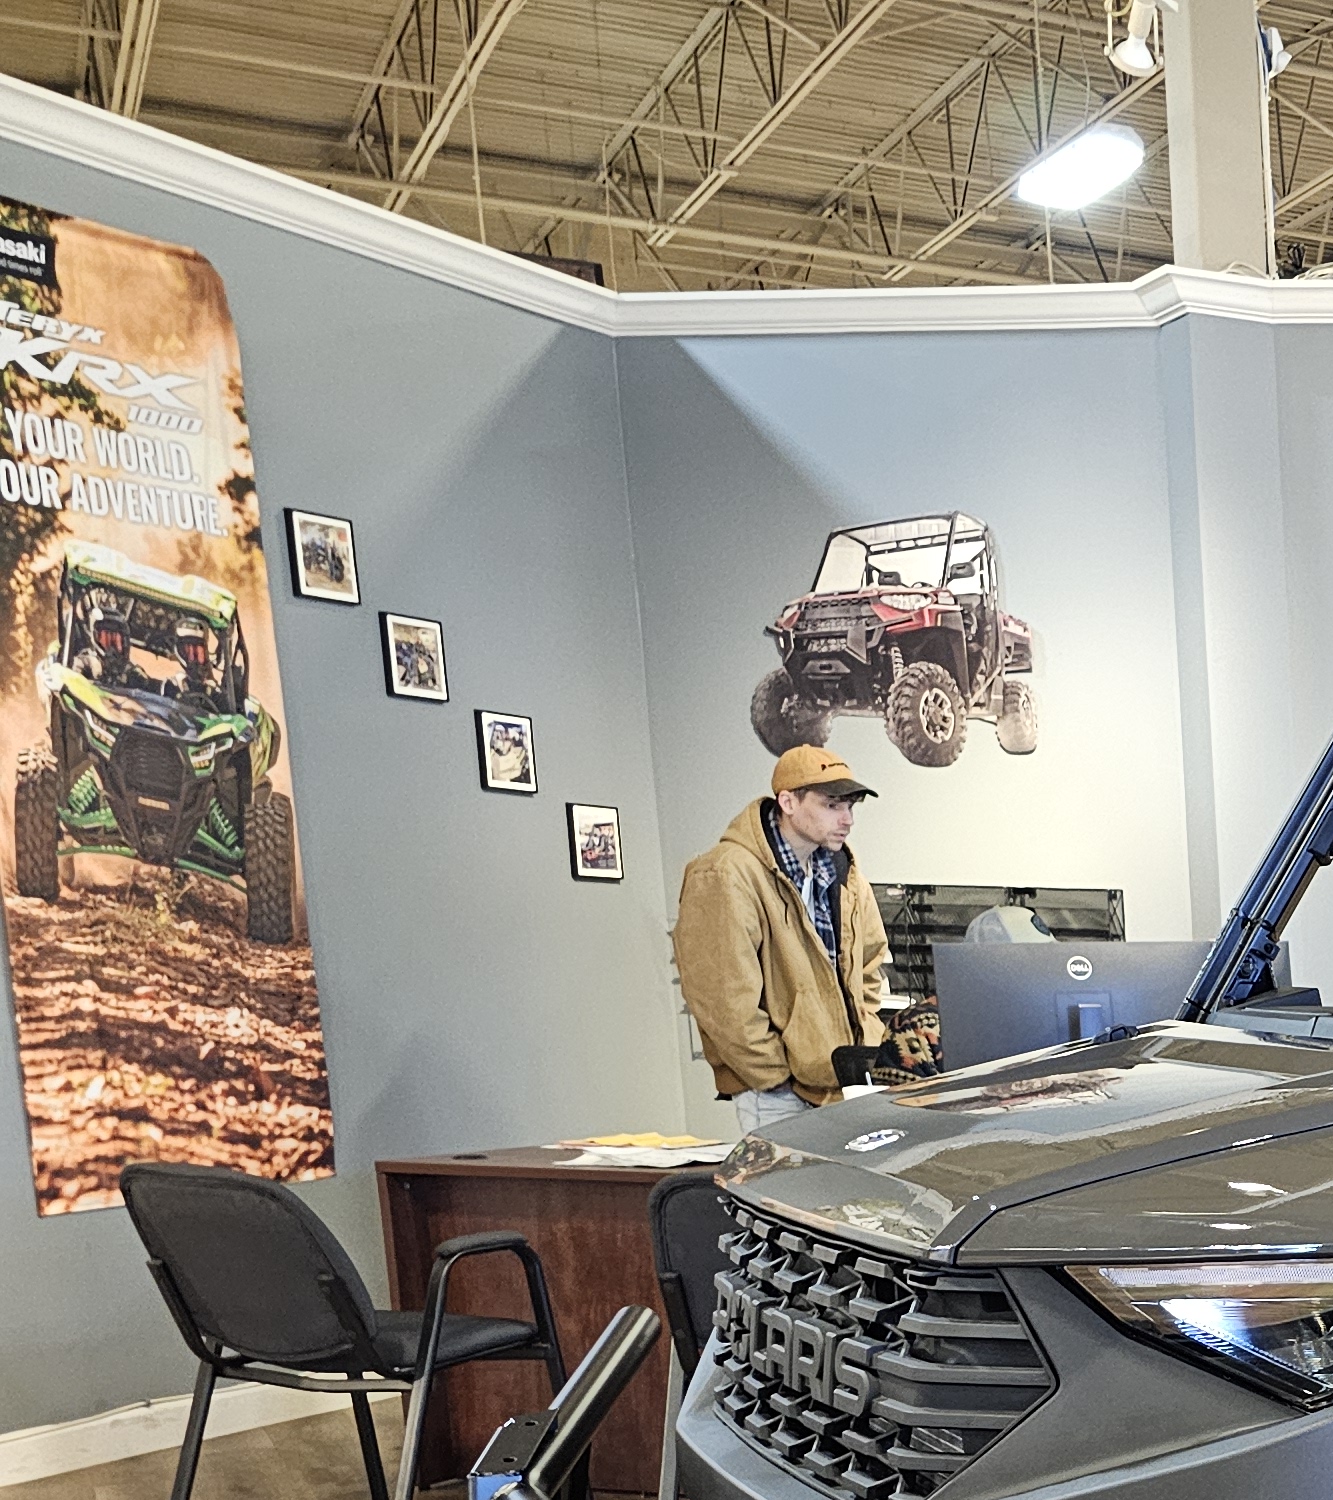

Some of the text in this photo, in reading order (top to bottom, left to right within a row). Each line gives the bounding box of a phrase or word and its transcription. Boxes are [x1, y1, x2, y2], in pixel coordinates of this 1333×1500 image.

[4, 407, 200, 484] YOUR WORLD.
[128, 405, 203, 435] 1000
[0, 457, 229, 537] OUR ADVENTURE.
[712, 1268, 881, 1419] POLARIS
